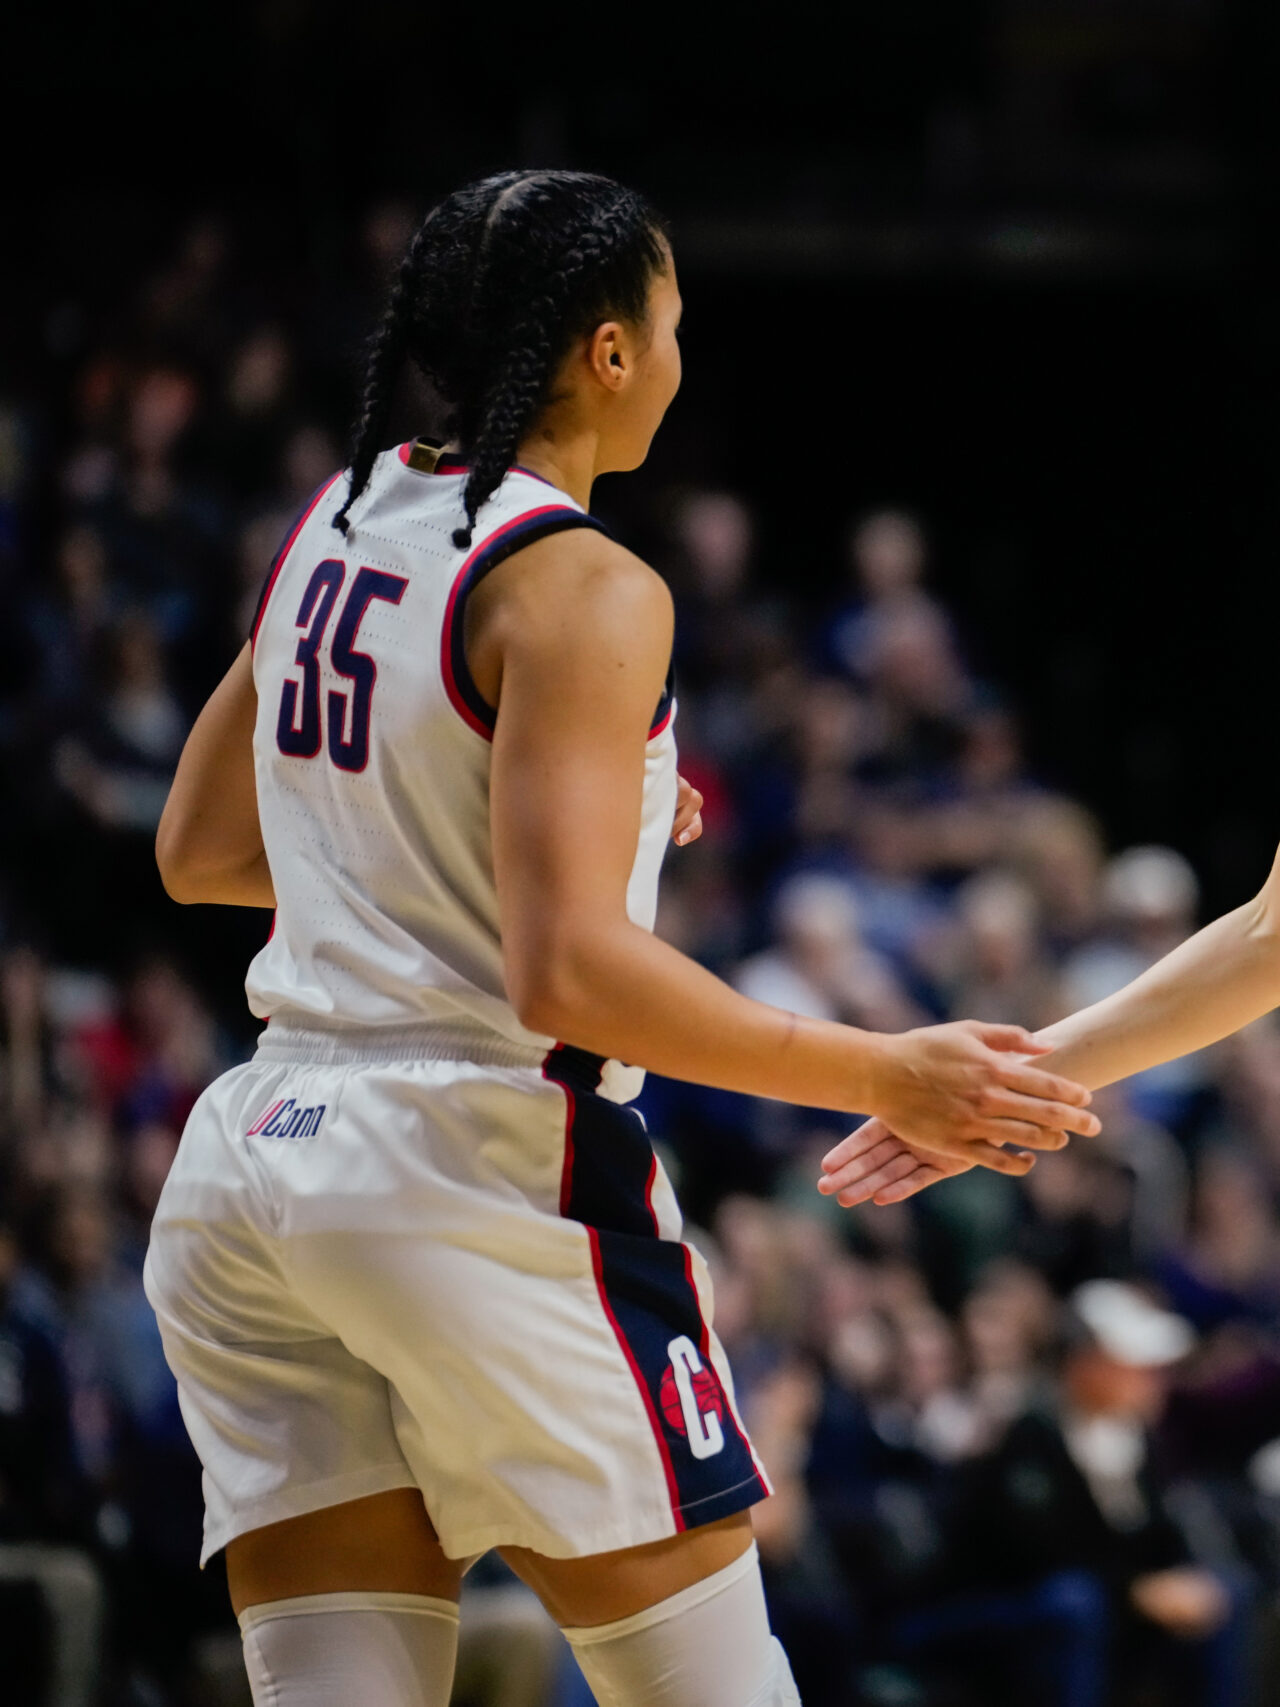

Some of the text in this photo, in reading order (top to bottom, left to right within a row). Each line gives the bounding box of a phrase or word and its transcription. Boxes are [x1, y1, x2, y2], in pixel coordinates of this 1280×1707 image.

[276, 559, 409, 773] 35
[246, 1098, 326, 1138] UConn
[667, 1334, 725, 1460] C
